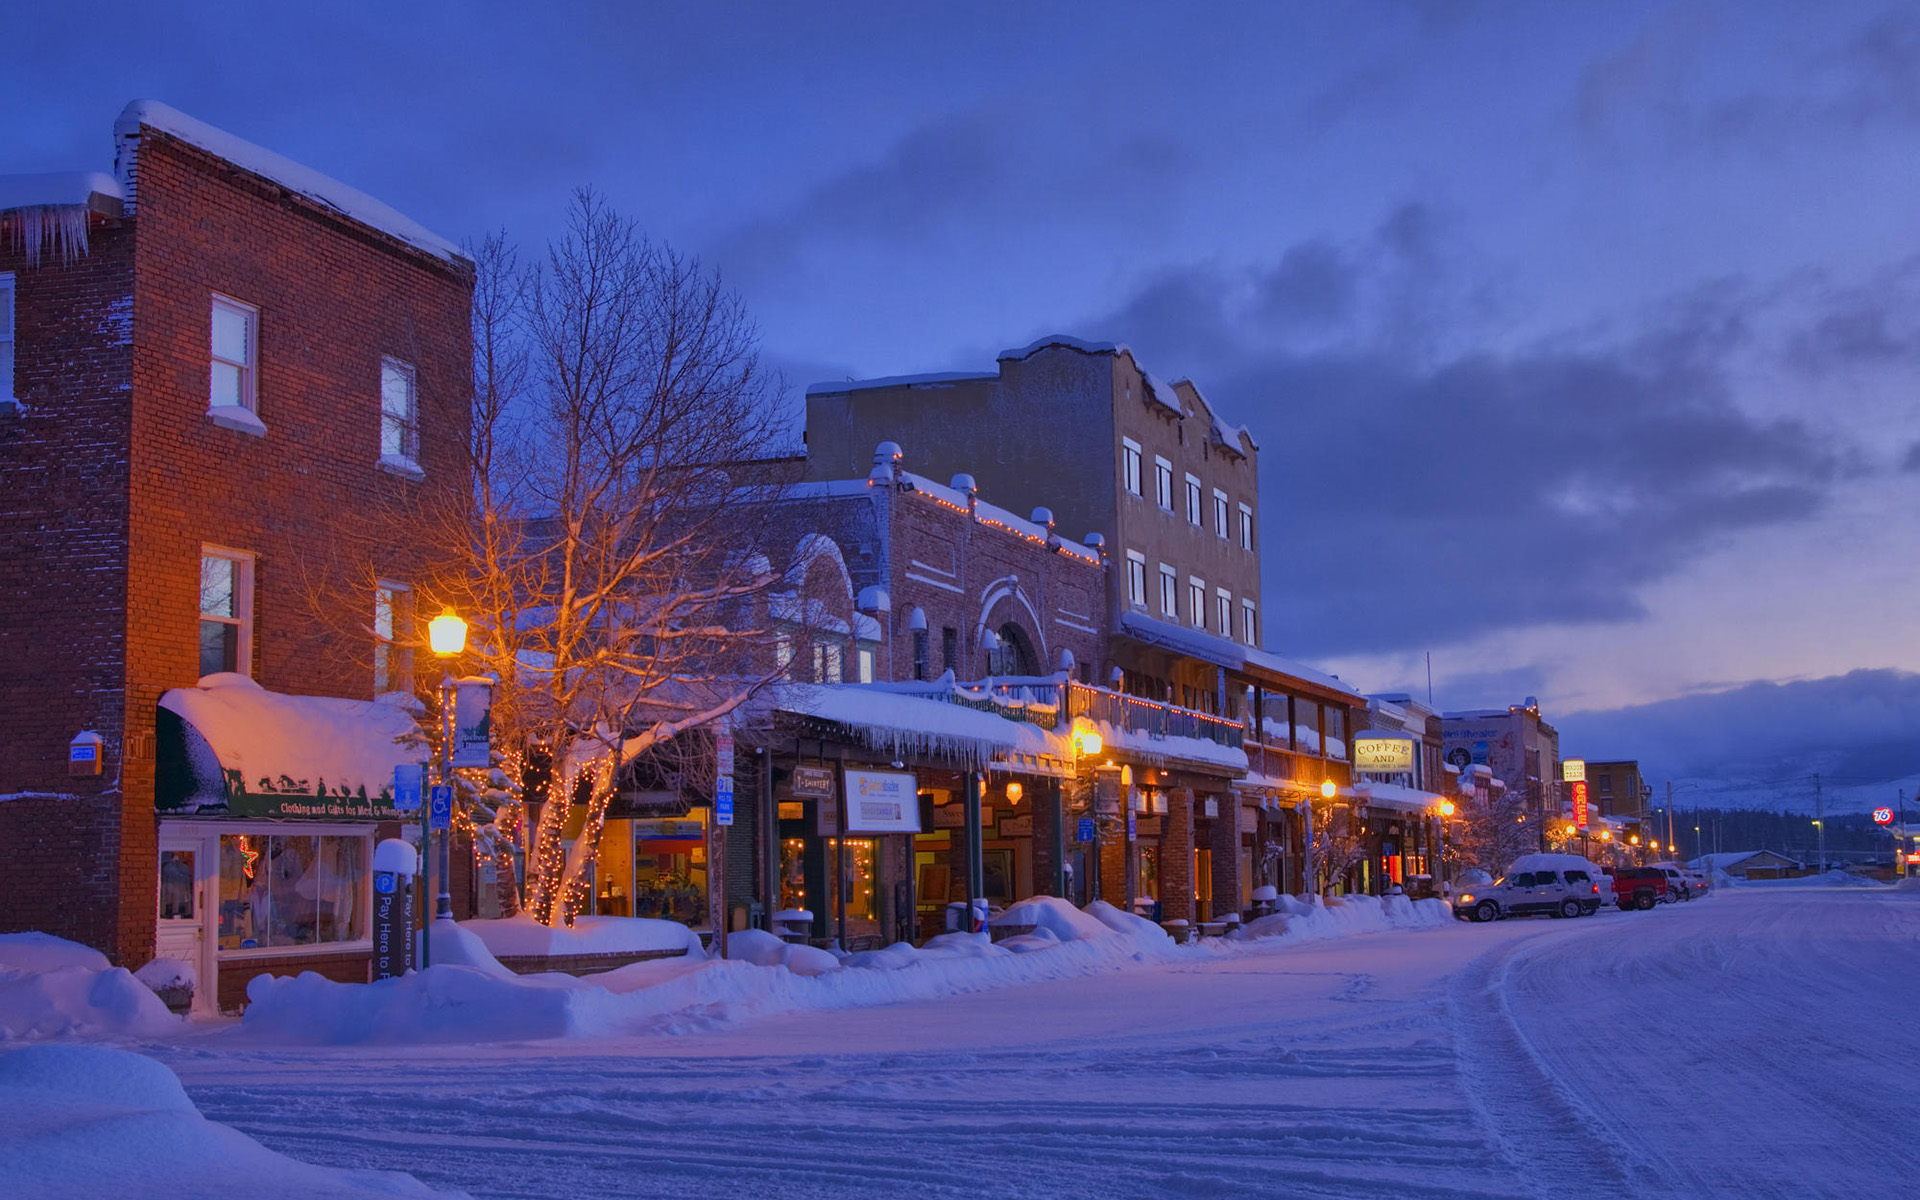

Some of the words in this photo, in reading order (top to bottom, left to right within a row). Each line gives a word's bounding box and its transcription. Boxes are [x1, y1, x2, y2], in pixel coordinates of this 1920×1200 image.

[1357, 743, 1410, 755] COFFEE
[1373, 755, 1395, 763] AND
[280, 802, 311, 816] Clothing
[311, 803, 326, 814] and
[327, 803, 345, 816] Gifts
[345, 803, 356, 816] for
[373, 805, 380, 816] &
[1576, 784, 1587, 825] CAFE
[1873, 809, 1890, 821] 76
[378, 896, 392, 920] Pay
[404, 894, 413, 918] Pay
[379, 923, 391, 953] Here
[404, 921, 413, 951] Here
[379, 956, 391, 969] to
[404, 954, 413, 967] to
